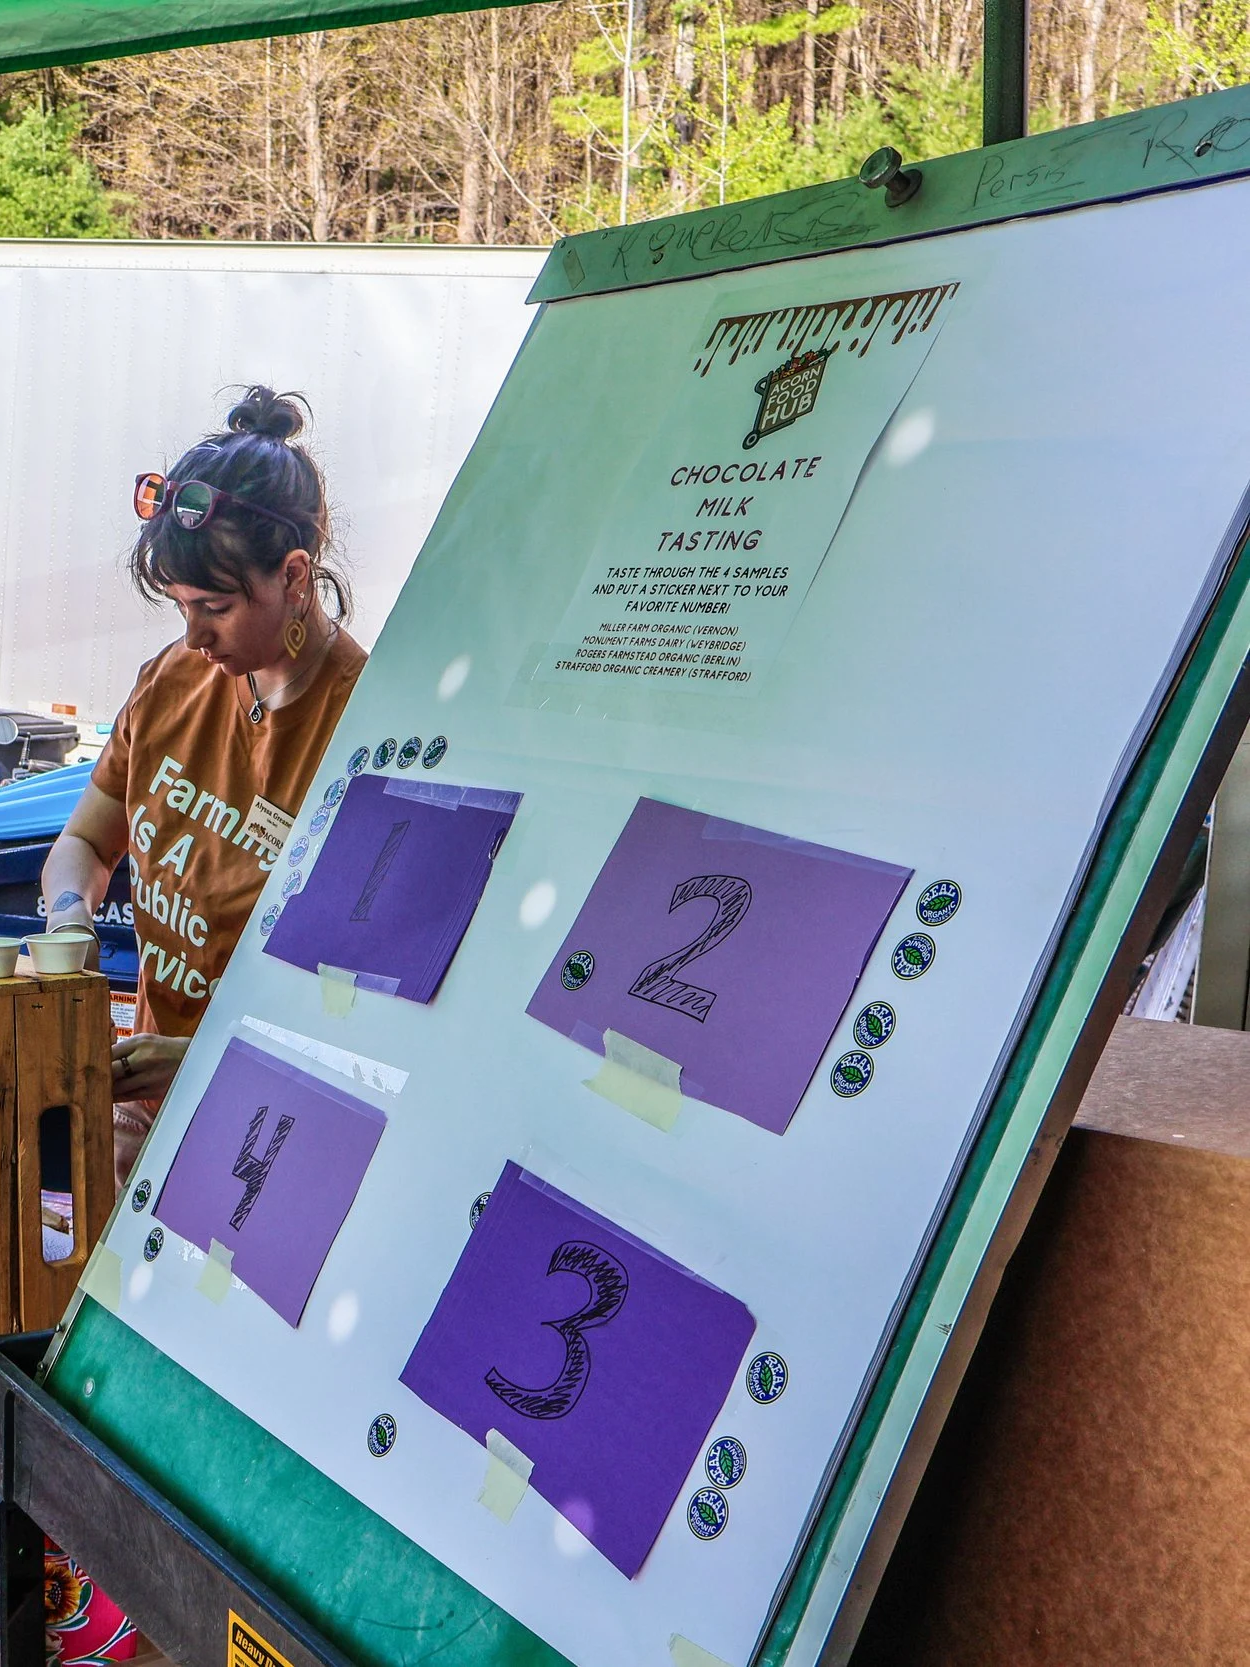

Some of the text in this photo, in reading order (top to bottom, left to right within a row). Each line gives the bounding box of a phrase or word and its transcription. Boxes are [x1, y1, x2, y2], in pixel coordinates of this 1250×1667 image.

[766, 378, 817, 410] FOOD
[770, 365, 822, 396] ACORN
[761, 393, 812, 430] HUB
[669, 456, 822, 487] CHOCOLATE
[695, 495, 755, 518] MILK
[656, 529, 764, 553] TASTING
[606, 566, 789, 579] TASTE THROUGH THE 4 SAMPLES
[591, 583, 789, 597] AND PUT A STICKER NEXT TO YOUR
[624, 600, 731, 615] FAVORITE NUMBER!
[582, 635, 746, 652] MONUMENT FARMS DAIRY (WEYBRIDGE)
[599, 623, 739, 636] MILLER FARM ORGANIC (VERNON)
[554, 660, 752, 683] STRAFFORD ORGANIC CREAMERY (STRAFFORD)
[575, 648, 741, 667] ROGERS FARMSTEAD ORGANIC (BERLIN)
[130, 804, 195, 877] Is A
[350, 820, 411, 922] 1
[920, 883, 956, 907] REAL
[922, 900, 956, 919] ORGANIC
[628, 875, 752, 1023] 2
[894, 949, 923, 976] REAL
[904, 939, 931, 962] ORGANIC
[110, 994, 137, 1004] ARNING
[859, 1016, 880, 1045] ORGANIC
[868, 1005, 893, 1037] REAL
[834, 1071, 863, 1090] ORGANIC
[840, 1054, 871, 1079] REAL
[228, 1105, 296, 1232] 4
[484, 1240, 629, 1420] 3
[752, 1360, 766, 1400] ORGANIC
[764, 1356, 784, 1396] REAL
[708, 1445, 730, 1486] REAL
[724, 1441, 740, 1479] ORGANIC
[691, 1505, 717, 1534] ORGANIC
[697, 1491, 726, 1524] REAL
[235, 1629, 265, 1665] Heavy
